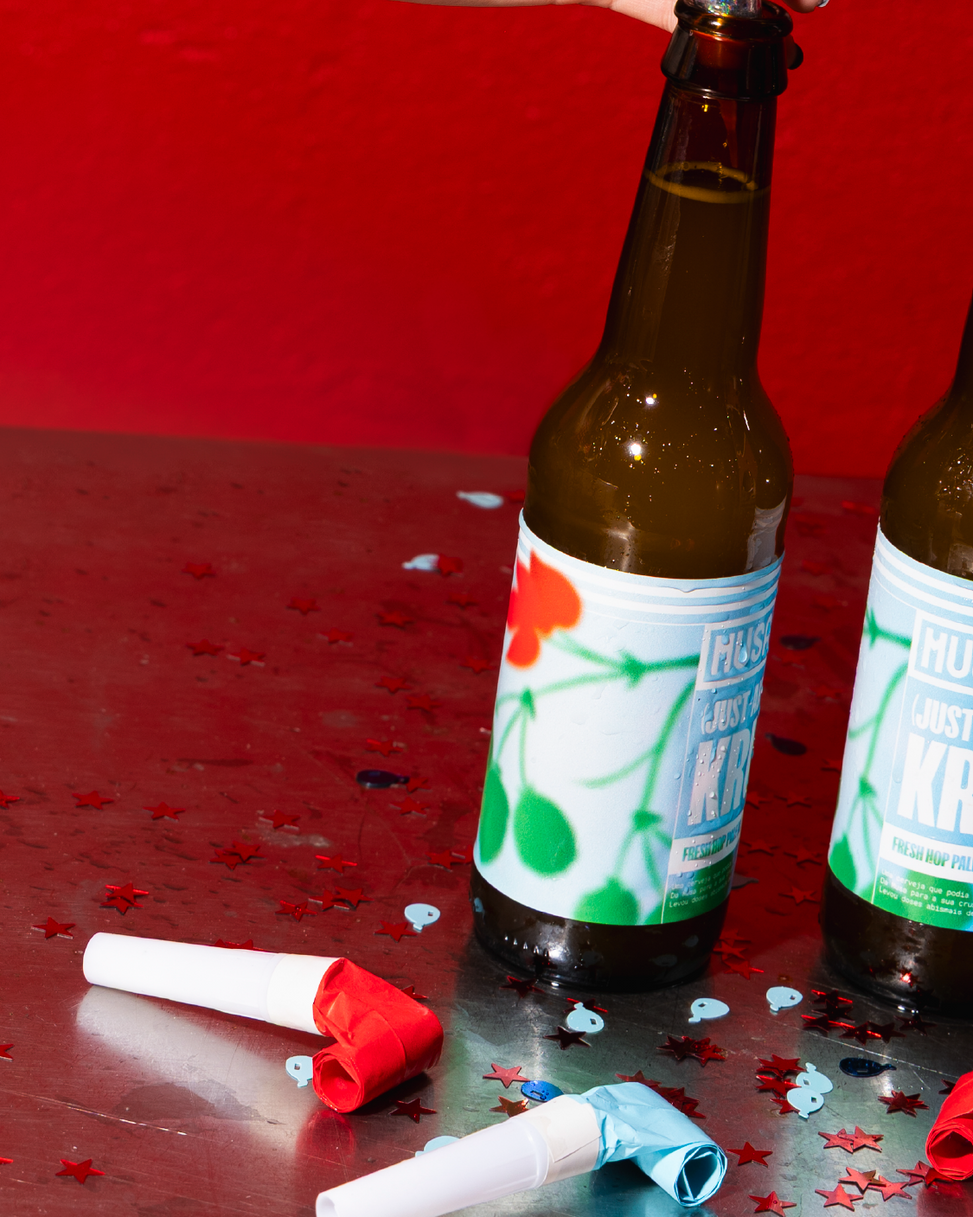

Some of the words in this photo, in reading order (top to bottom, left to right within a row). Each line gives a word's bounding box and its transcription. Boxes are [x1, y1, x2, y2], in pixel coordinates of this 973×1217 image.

[891, 836, 925, 862] FRESH
[925, 848, 950, 867] HOP
[879, 885, 899, 900] Levou
[901, 896, 923, 908] doses
[926, 902, 963, 916] abismais
[910, 890, 928, 901] para
[941, 898, 955, 906] sua
[929, 886, 943, 895] que
[946, 890, 969, 899] podia
